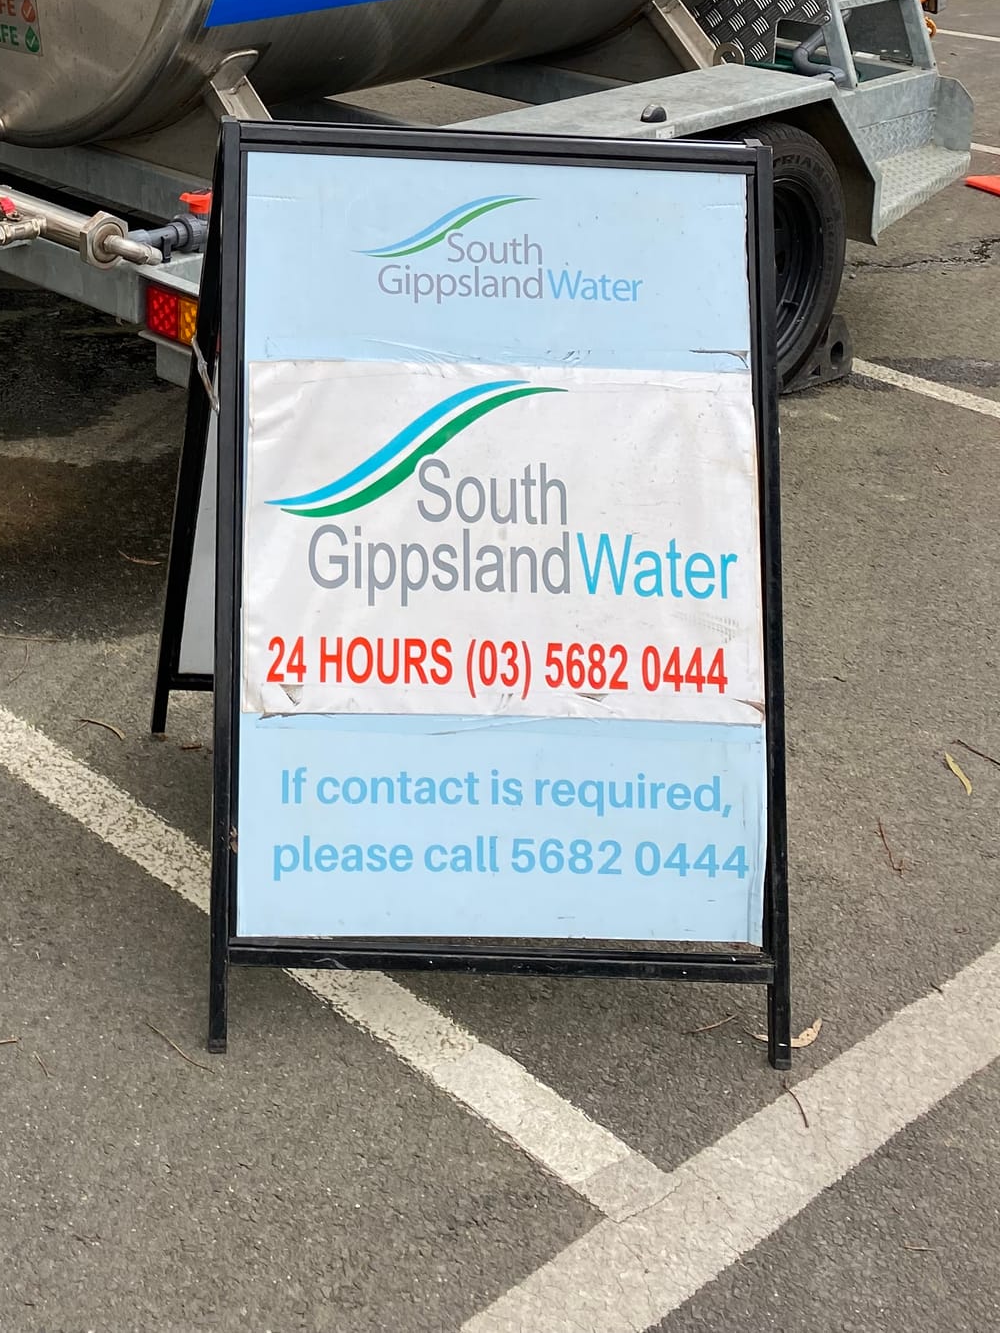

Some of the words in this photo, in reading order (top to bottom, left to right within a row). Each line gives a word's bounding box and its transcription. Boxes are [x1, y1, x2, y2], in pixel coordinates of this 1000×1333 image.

[446, 232, 543, 266] South
[417, 458, 567, 525] South
[266, 636, 307, 683] 24
[319, 636, 453, 685] HOURS
[466, 638, 532, 700] (03)
[545, 642, 629, 691] 5682
[642, 646, 728, 694] 0444
[281, 767, 306, 805] If
[316, 771, 480, 806] contact
[491, 770, 523, 806] is
[534, 772, 732, 818] required,
[273, 835, 414, 882] please
[424, 835, 499, 874] call
[511, 837, 622, 876] 5682
[634, 840, 749, 879] 0444
